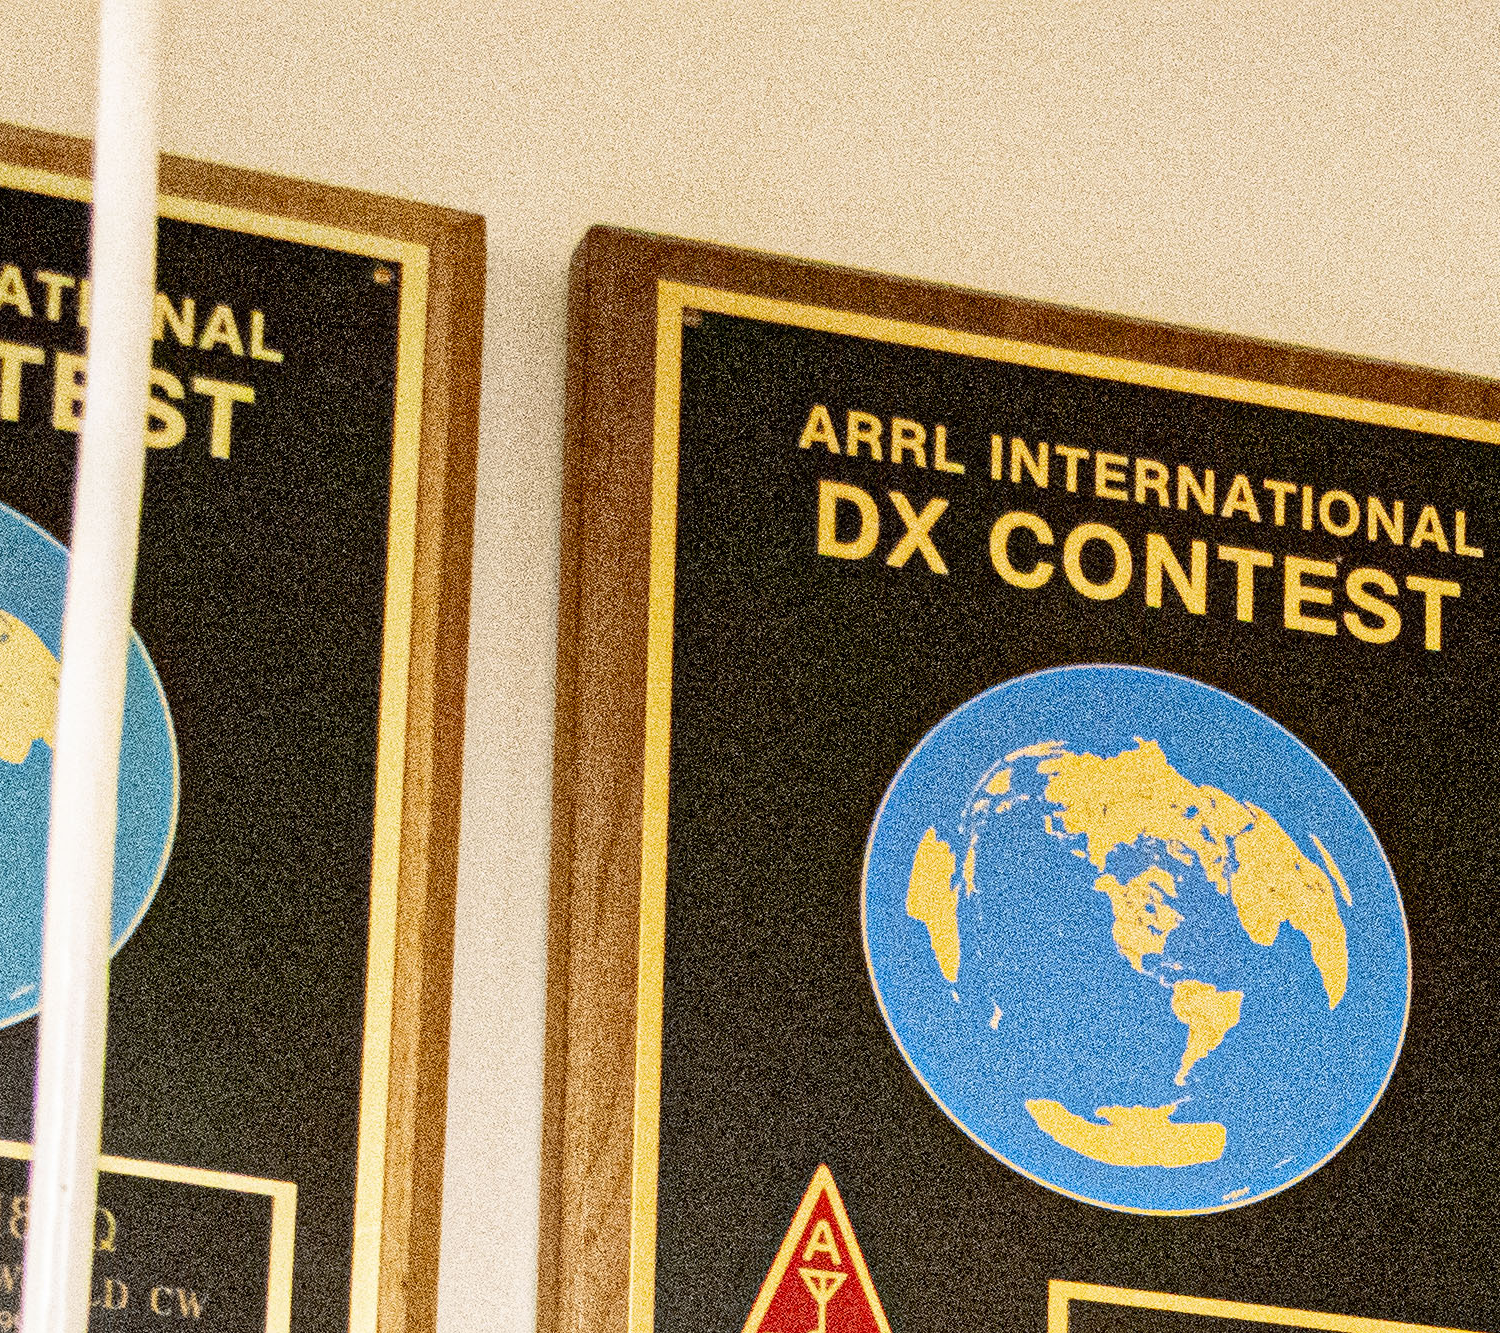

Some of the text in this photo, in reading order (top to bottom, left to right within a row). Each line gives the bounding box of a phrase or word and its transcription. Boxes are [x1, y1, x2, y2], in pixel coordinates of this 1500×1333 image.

[800, 404, 1484, 558] ARRL INTERNATIONAL
[817, 479, 1462, 651] DX CONTEST
[149, 1284, 208, 1320] CW
